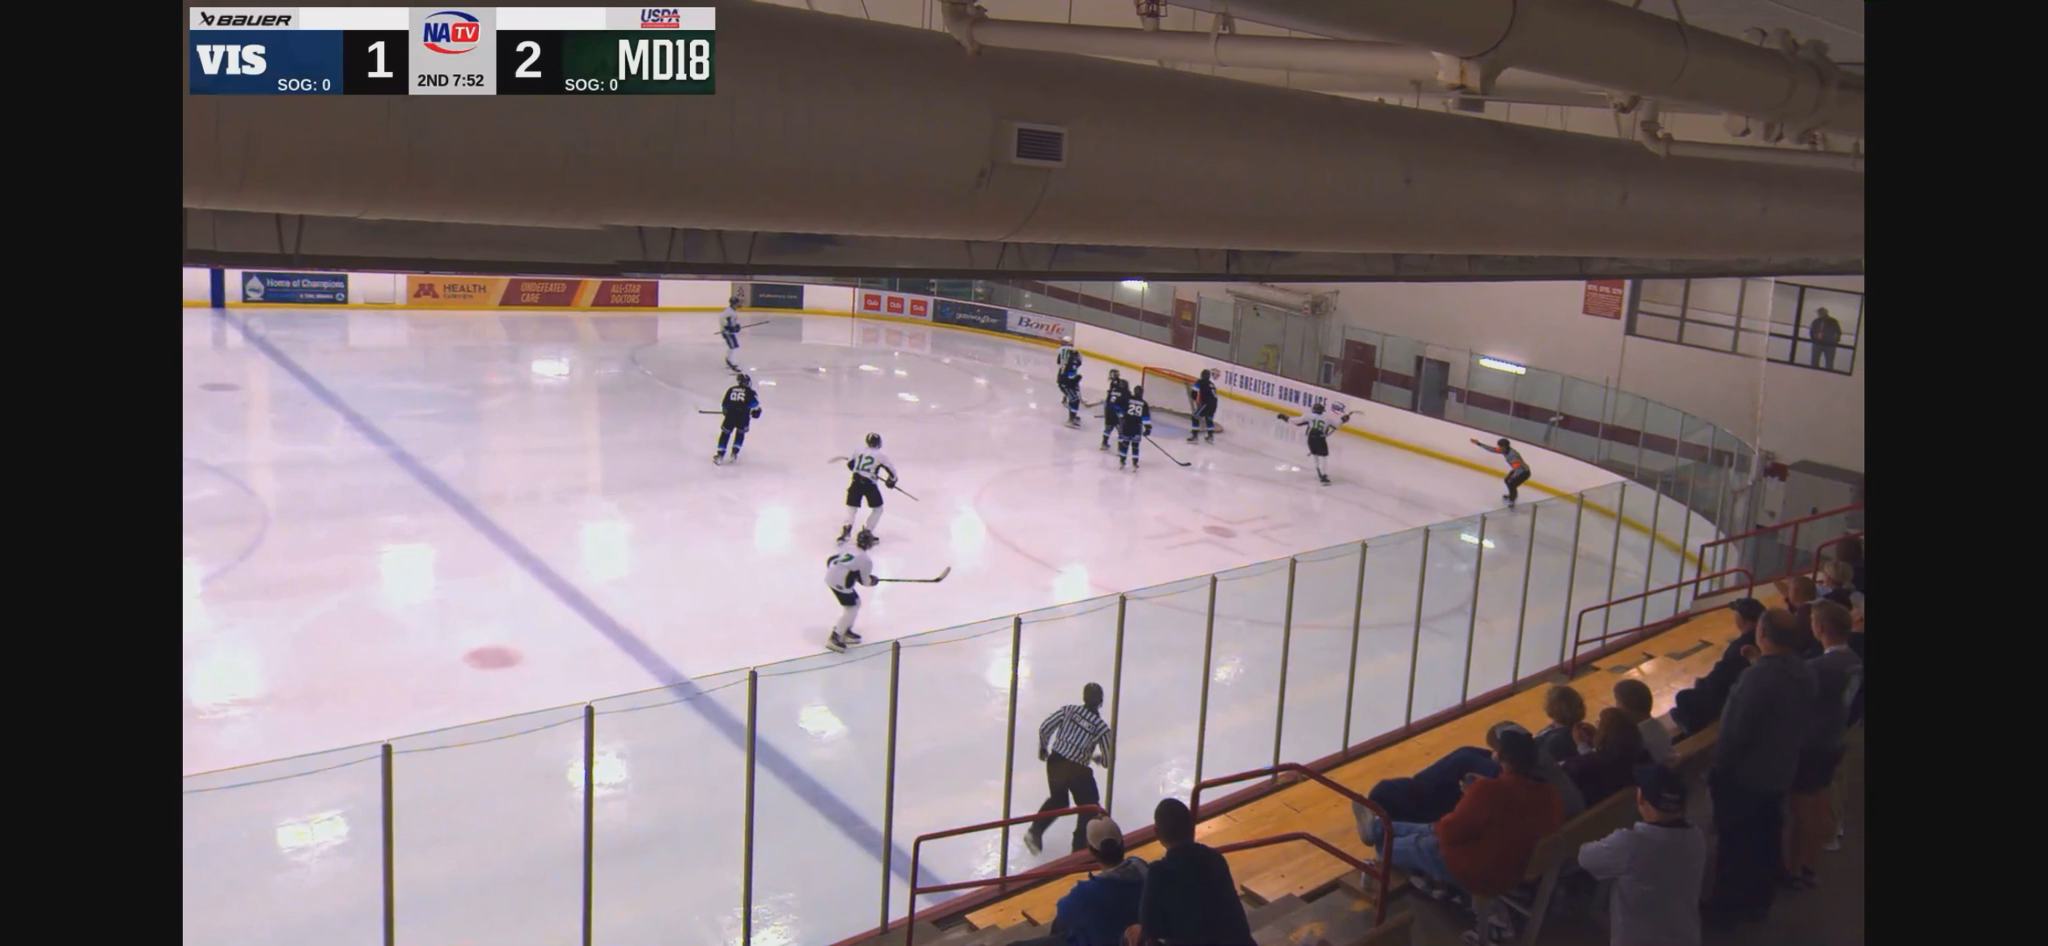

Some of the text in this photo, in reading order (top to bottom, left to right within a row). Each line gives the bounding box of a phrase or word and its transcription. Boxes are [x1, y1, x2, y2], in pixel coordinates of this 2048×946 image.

[266, 278, 345, 290] Home of Champions
[443, 283, 487, 294] HEALTH
[520, 281, 567, 294] UNDEFEATED
[610, 283, 642, 294] ALL-STAR
[520, 293, 541, 303] CARE
[610, 294, 641, 304] DOCTORS
[1018, 316, 1065, 334] Bonfe
[1225, 370, 1238, 387] THE
[1239, 374, 1276, 397] GREATEST
[1278, 385, 1300, 404] SHOW
[1302, 391, 1313, 408] ON
[1127, 404, 1143, 417] 29
[1312, 419, 1326, 430] 16
[855, 454, 875, 472] 12
